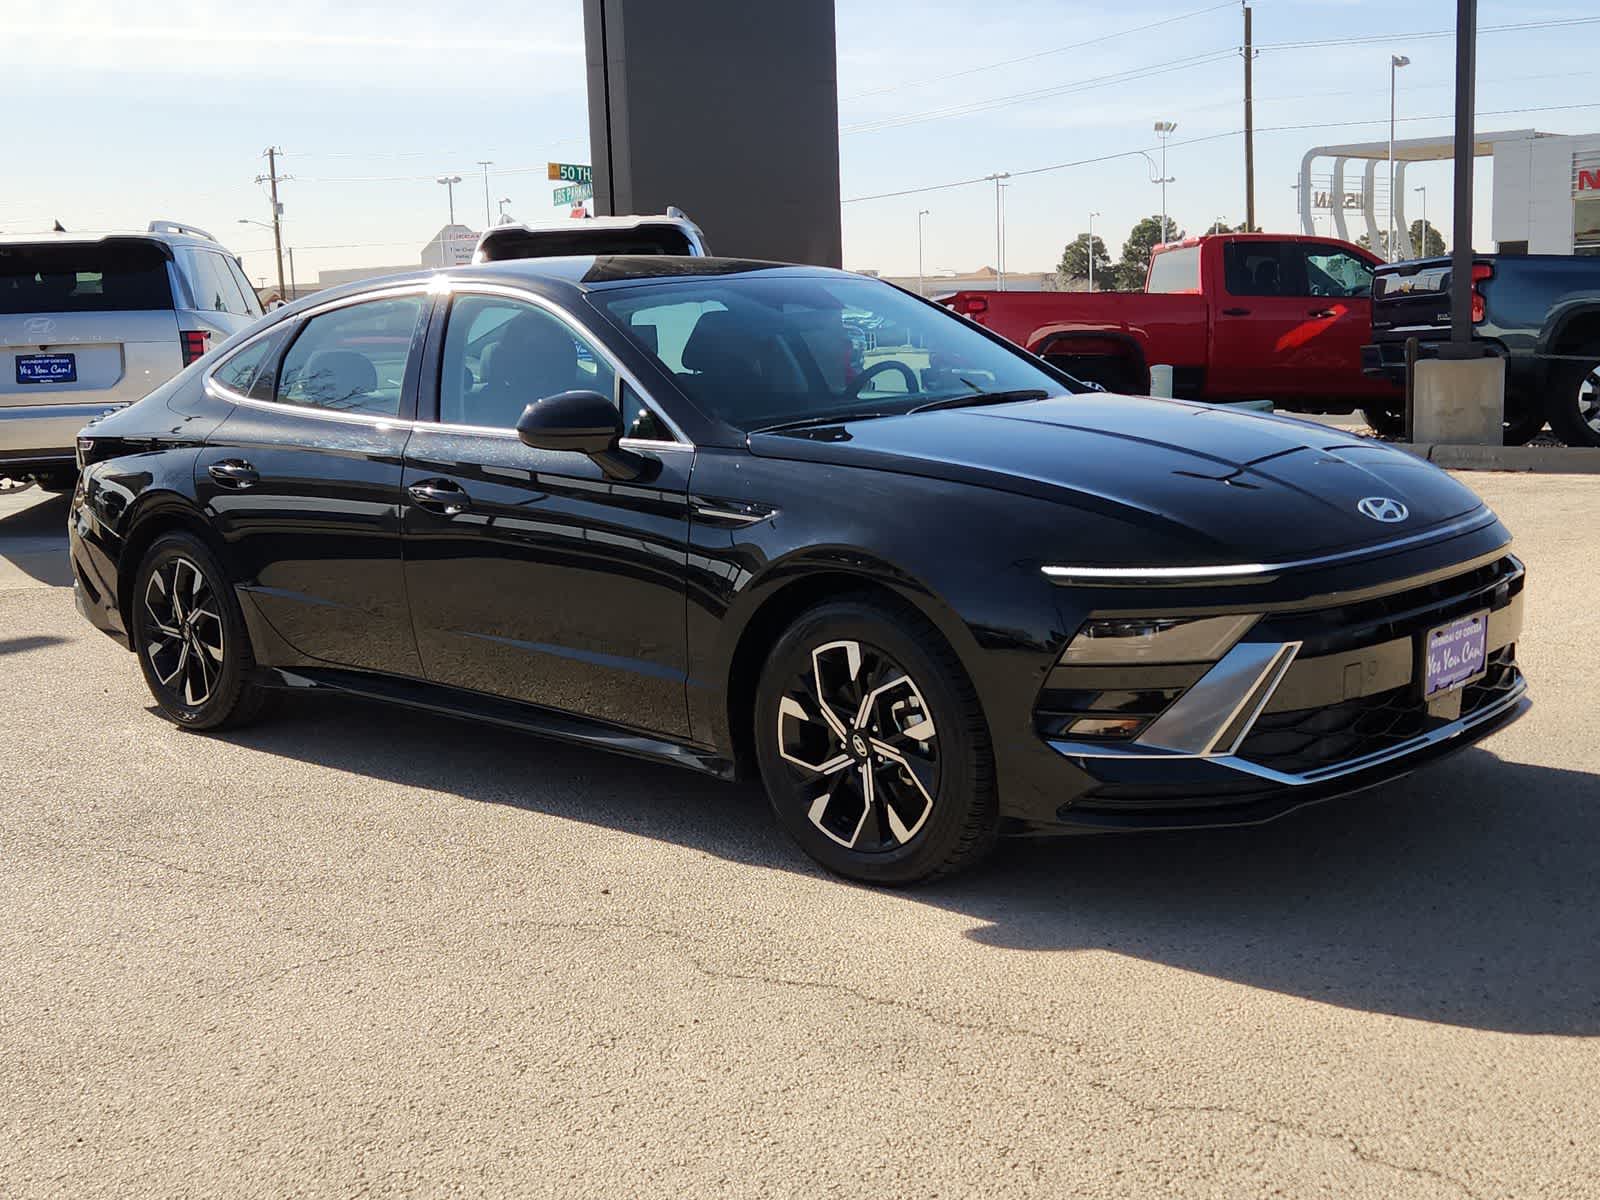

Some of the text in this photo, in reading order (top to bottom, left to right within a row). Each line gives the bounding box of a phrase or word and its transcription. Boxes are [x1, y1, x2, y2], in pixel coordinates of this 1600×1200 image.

[20, 364, 71, 375] Yes You Can!
[1427, 653, 1441, 677] Yes
[1443, 647, 1461, 671] You
[1461, 634, 1484, 663] Can!
